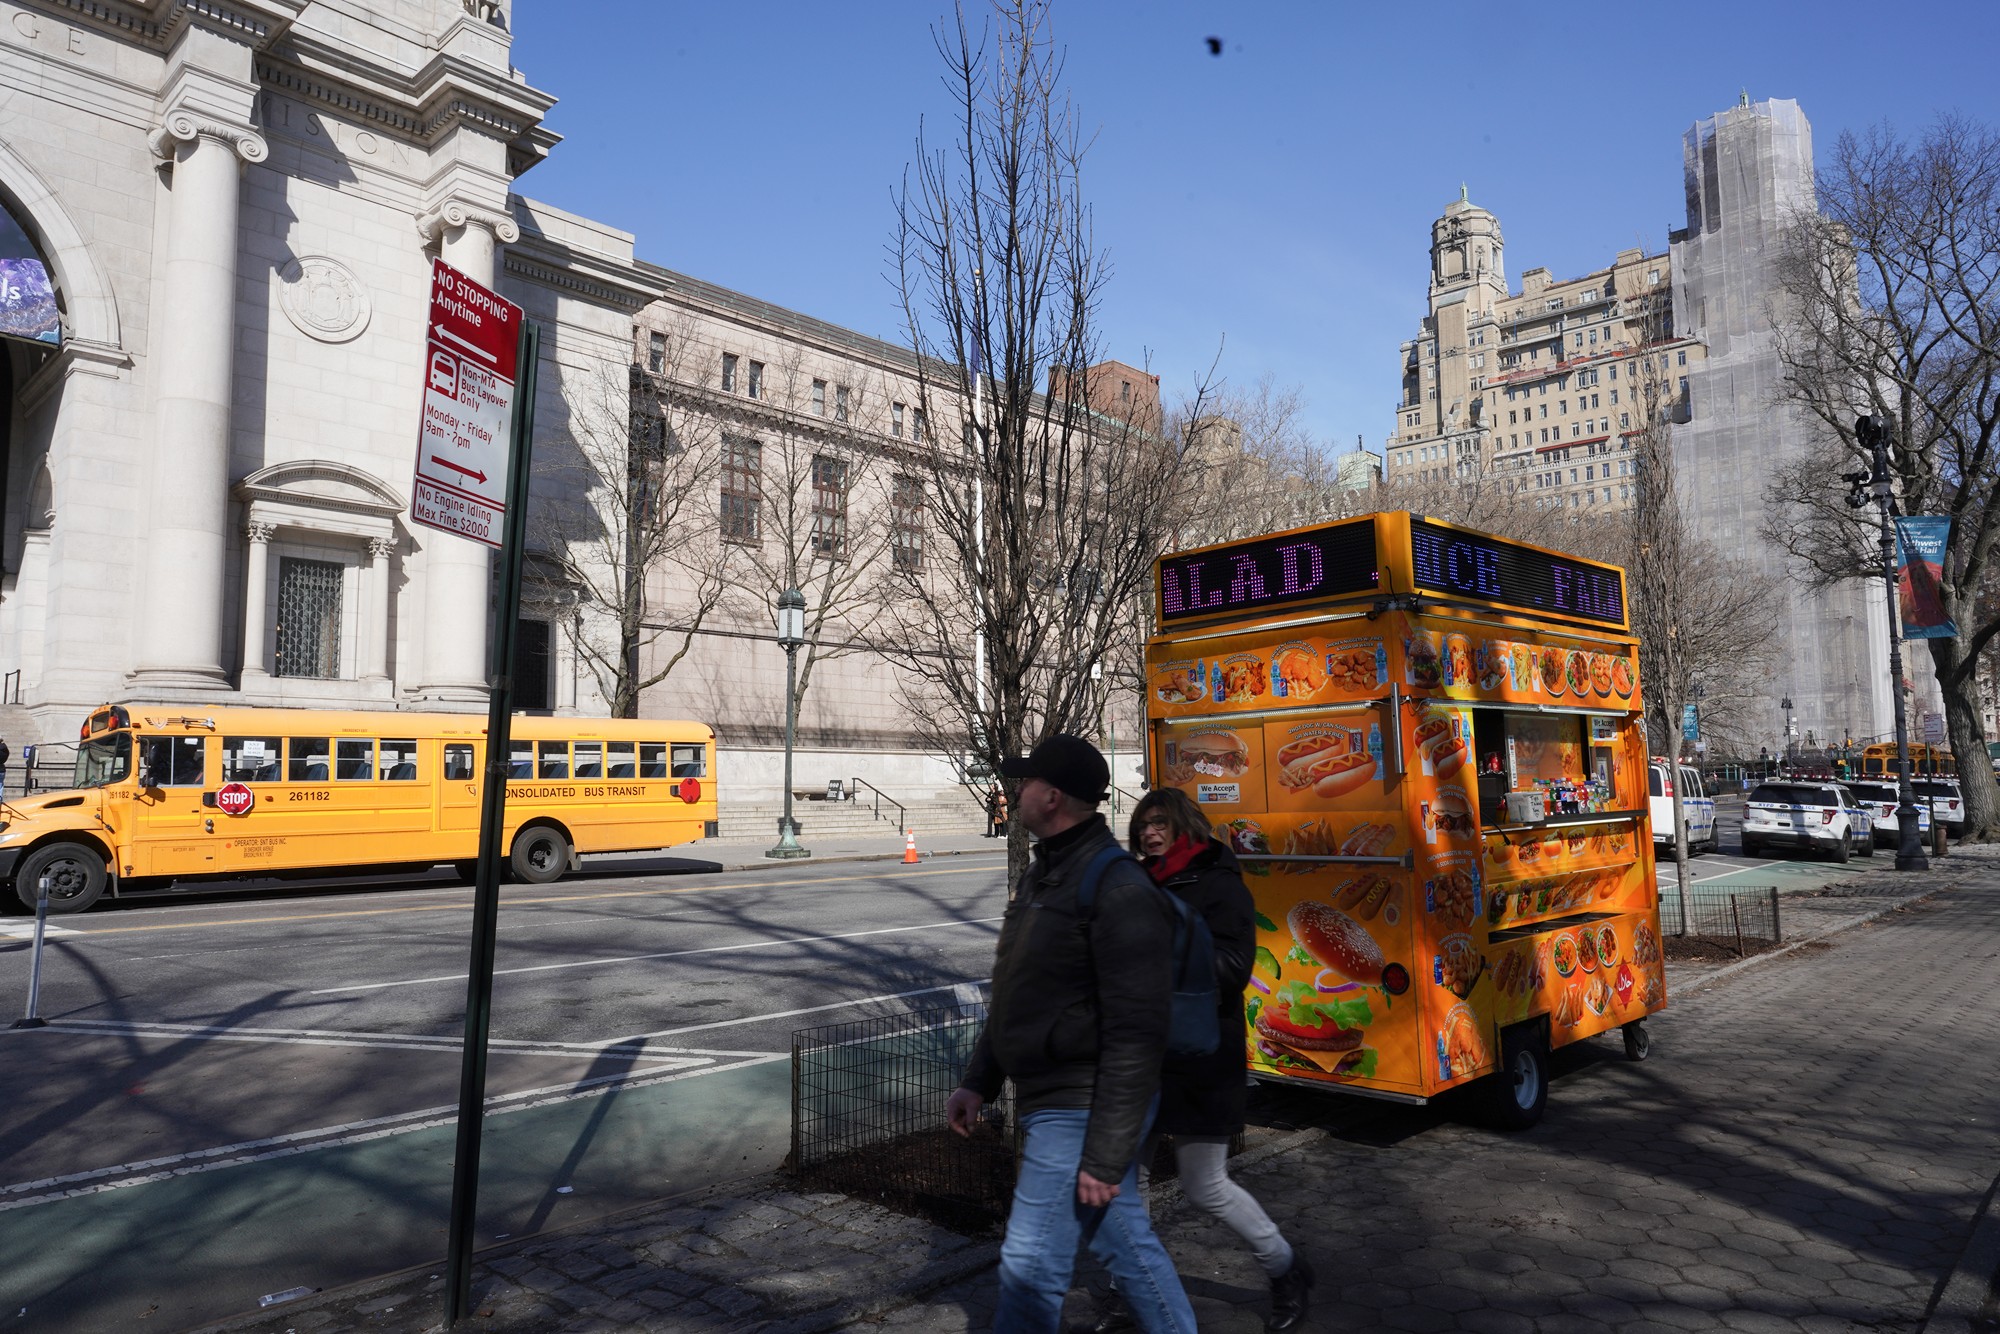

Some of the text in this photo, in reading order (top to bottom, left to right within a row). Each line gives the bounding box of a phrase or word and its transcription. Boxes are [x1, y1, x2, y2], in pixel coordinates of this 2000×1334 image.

[437, 268, 508, 322] NO STOPPING
[436, 289, 482, 328] Anytime
[462, 364, 497, 391] Non-MTA
[460, 392, 480, 413] Only
[461, 379, 507, 410] Bus Layover
[425, 420, 445, 440] 9am
[426, 403, 460, 431] Monday
[467, 423, 493, 445] Friday
[419, 485, 492, 523] No Engine Idling
[417, 505, 490, 538] Max Fine $2000
[1920, 546, 1938, 554] Hall
[1303, 729, 1322, 737] WATER
[1328, 730, 1345, 739] FRIES
[1334, 723, 1350, 733] SODA
[222, 792, 248, 804] STOP
[289, 791, 330, 801] 261182
[584, 786, 604, 796] BUS
[606, 786, 646, 796] TRANSIT
[234, 838, 259, 847] OPERATOR:
